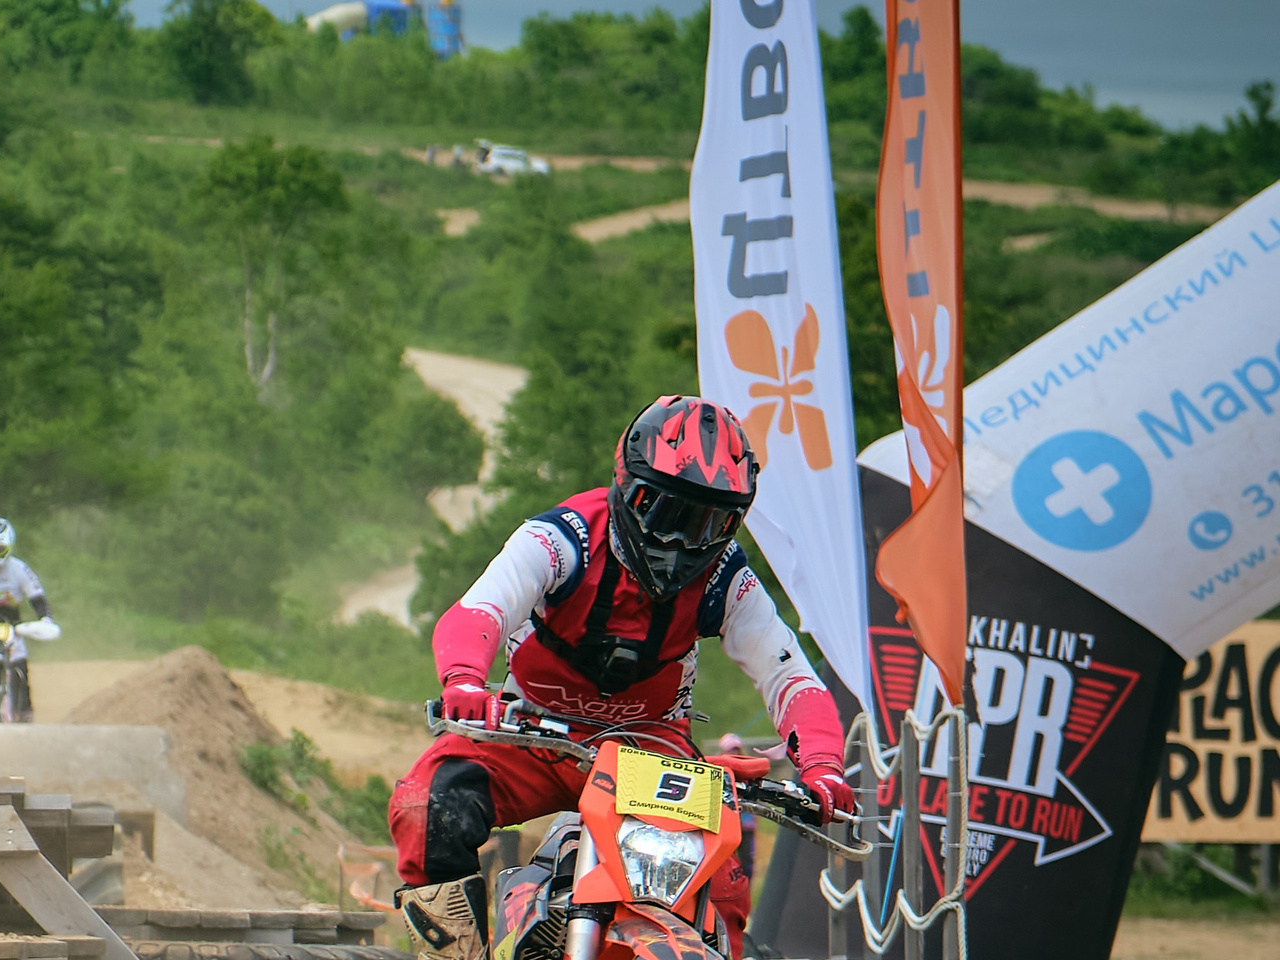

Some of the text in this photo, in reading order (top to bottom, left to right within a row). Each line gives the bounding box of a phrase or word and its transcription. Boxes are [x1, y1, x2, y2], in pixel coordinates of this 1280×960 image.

[1137, 338, 1280, 459] Мар
[1190, 533, 1280, 601] www.
[661, 759, 705, 775] GOLD
[594, 778, 615, 790] KTM
[655, 772, 693, 802] 5
[629, 800, 705, 821] Смирнов Борис
[995, 790, 1029, 829] TO
[1032, 797, 1084, 843] RUN
